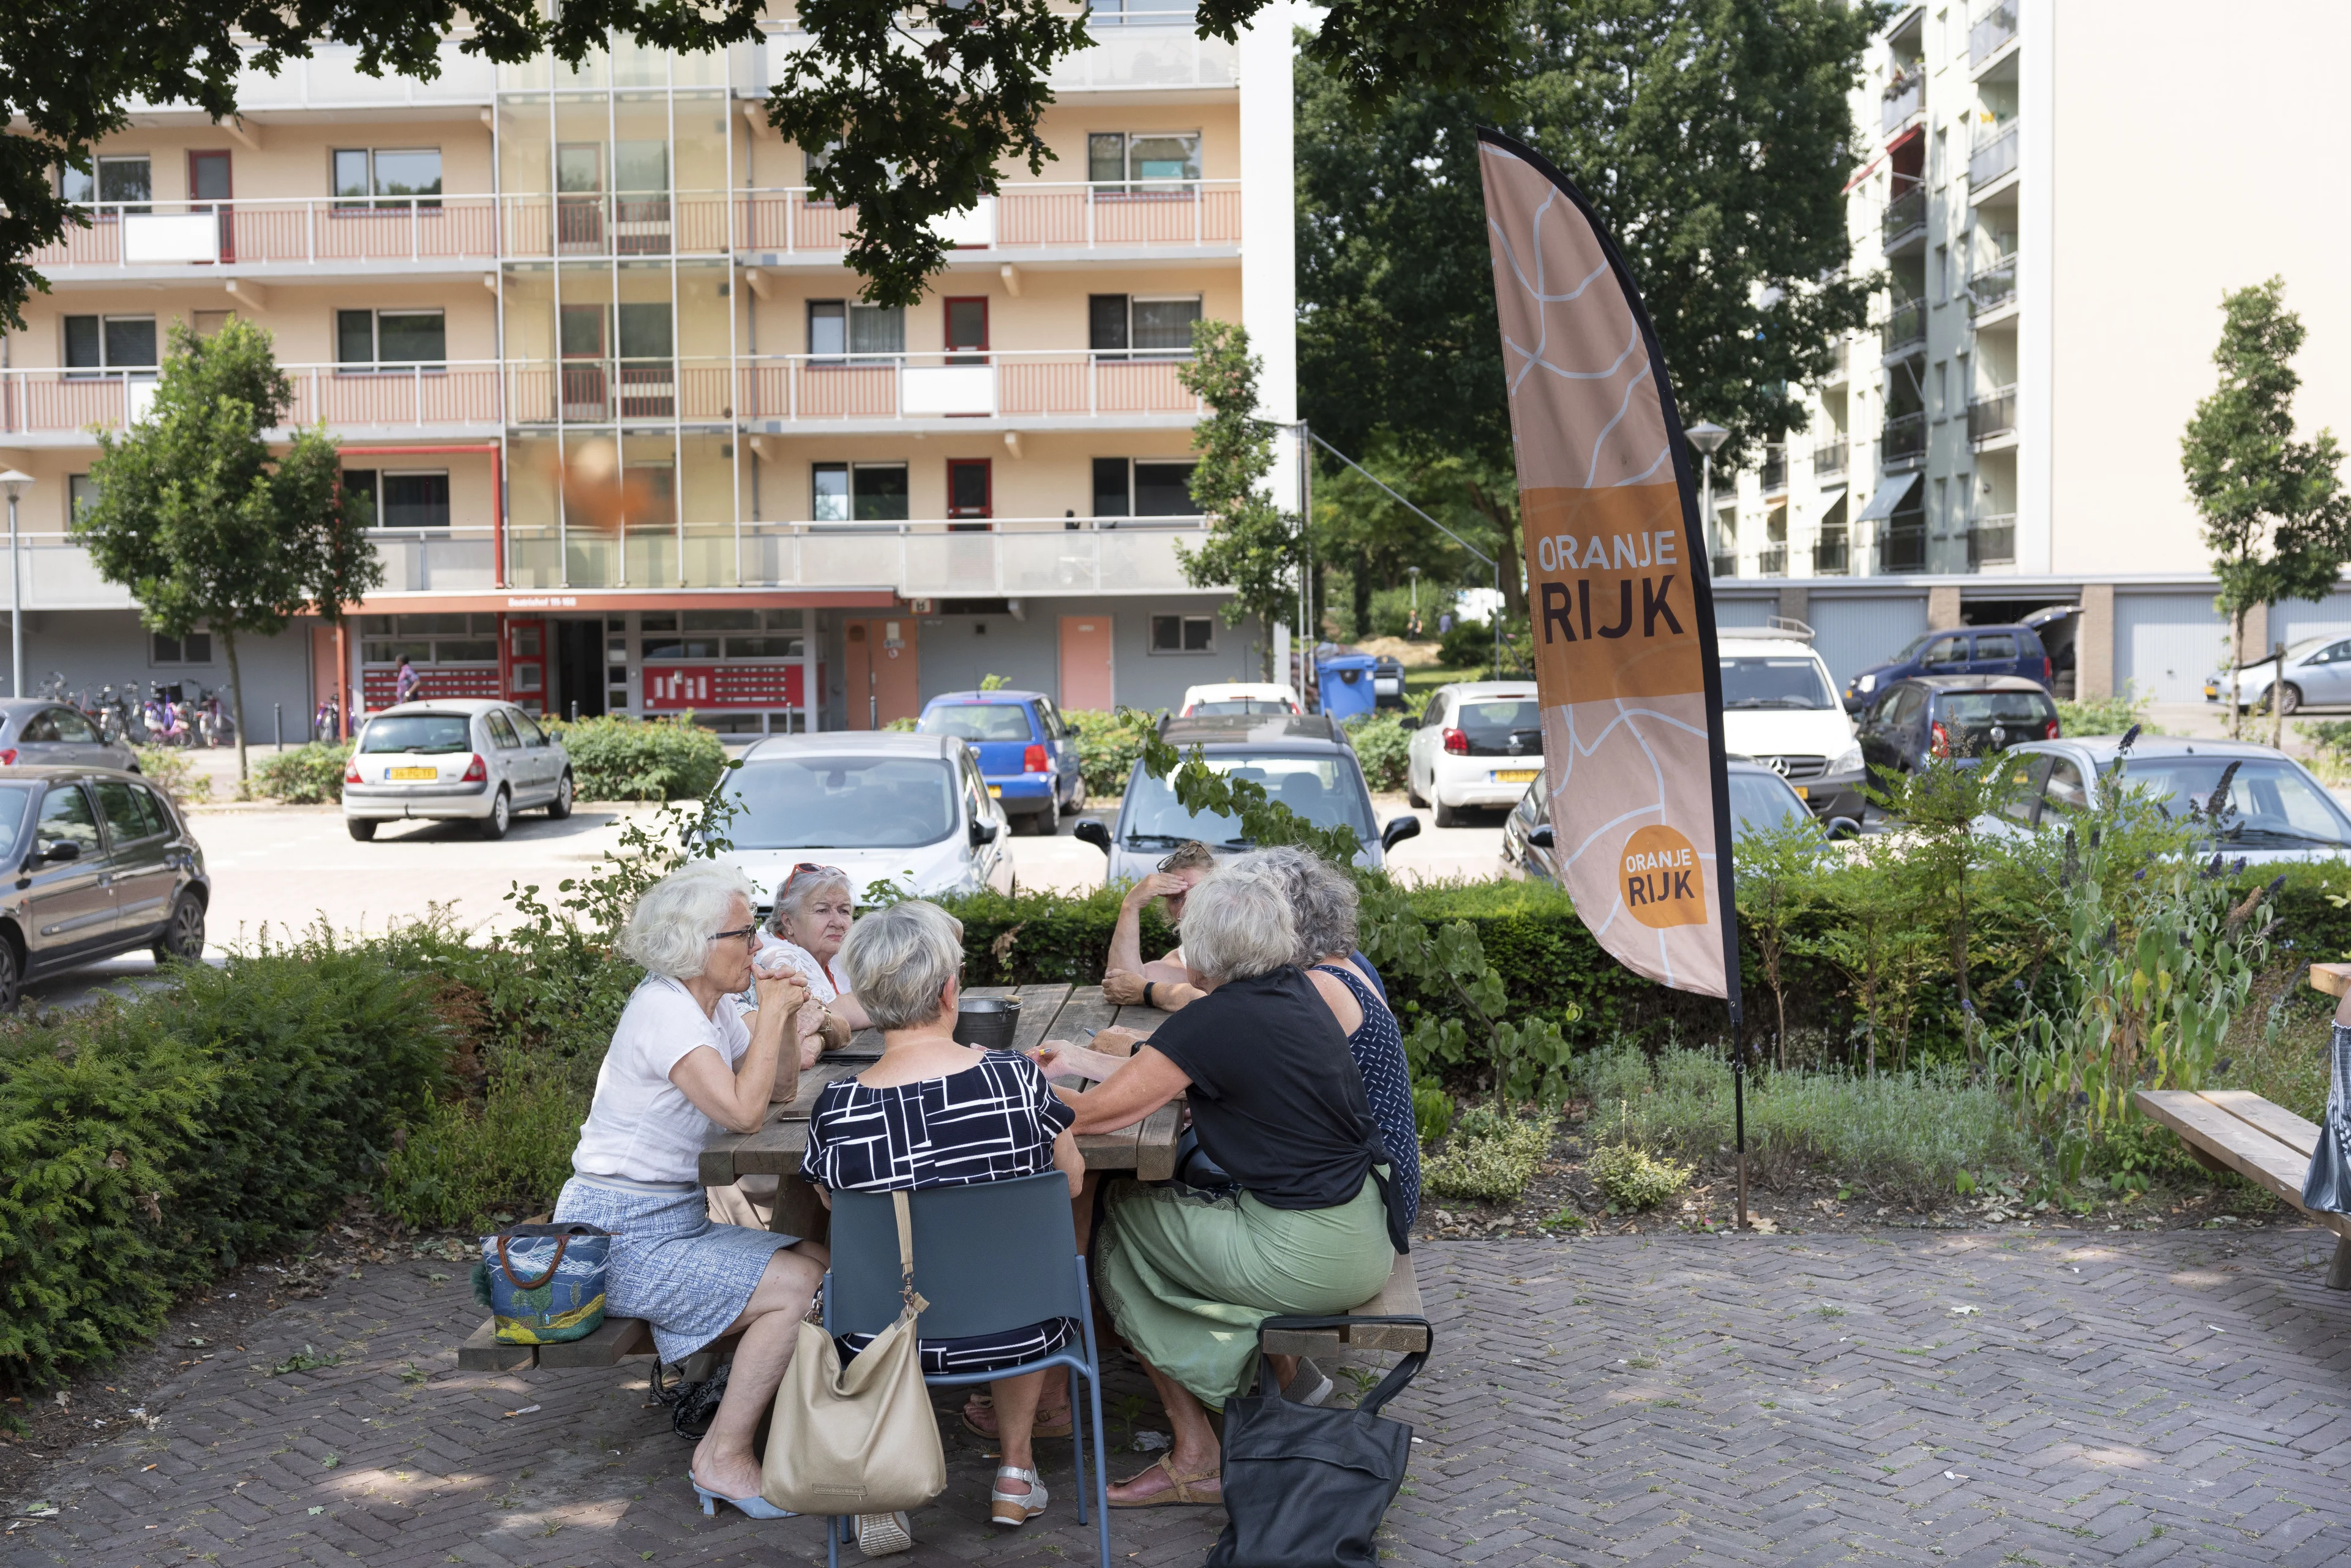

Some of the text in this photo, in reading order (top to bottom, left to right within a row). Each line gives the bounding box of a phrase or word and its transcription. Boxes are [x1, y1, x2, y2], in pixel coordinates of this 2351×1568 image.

[1539, 530, 1677, 572] ORANJE
[1541, 574, 1684, 644] RIJK
[1626, 849, 1692, 872] ORANJE
[1629, 870, 1695, 906] RIJK
